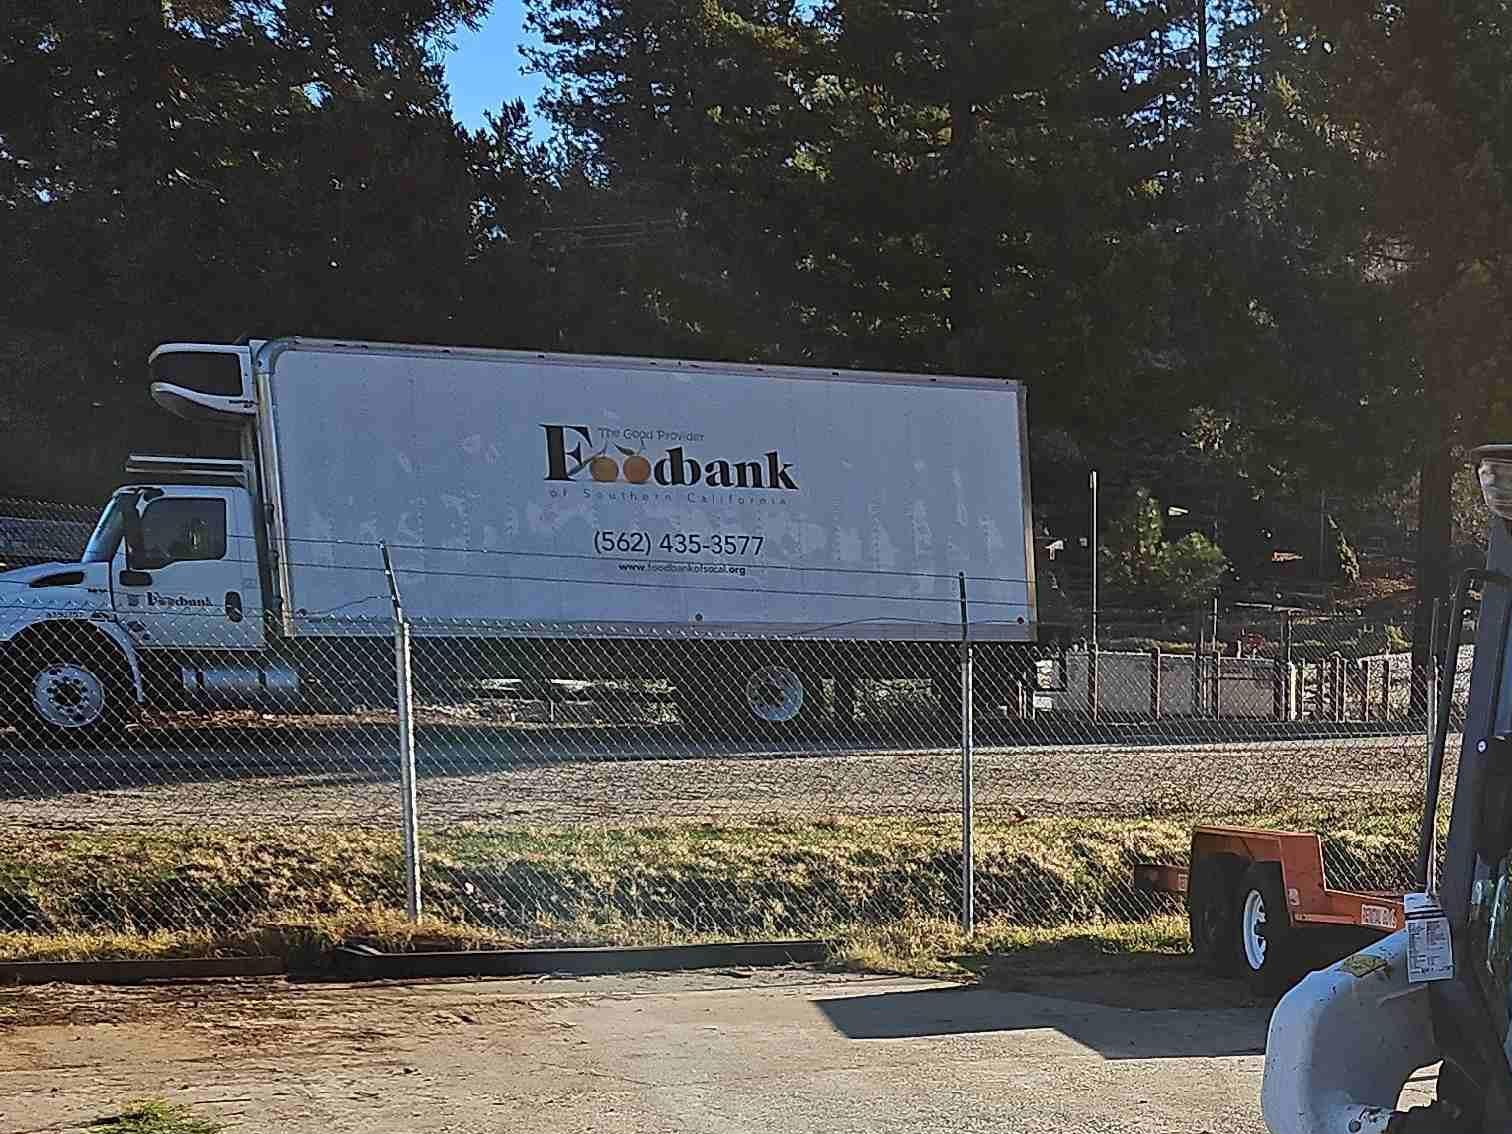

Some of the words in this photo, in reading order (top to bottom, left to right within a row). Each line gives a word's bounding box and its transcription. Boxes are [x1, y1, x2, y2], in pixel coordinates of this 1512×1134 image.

[598, 427, 619, 441] The
[623, 428, 653, 442] Good
[657, 430, 705, 442] Provider
[539, 422, 799, 491] Foodbank
[583, 488, 673, 502] Southern
[687, 492, 788, 505] California
[593, 531, 651, 556] (562)
[659, 534, 765, 557] 435-3577
